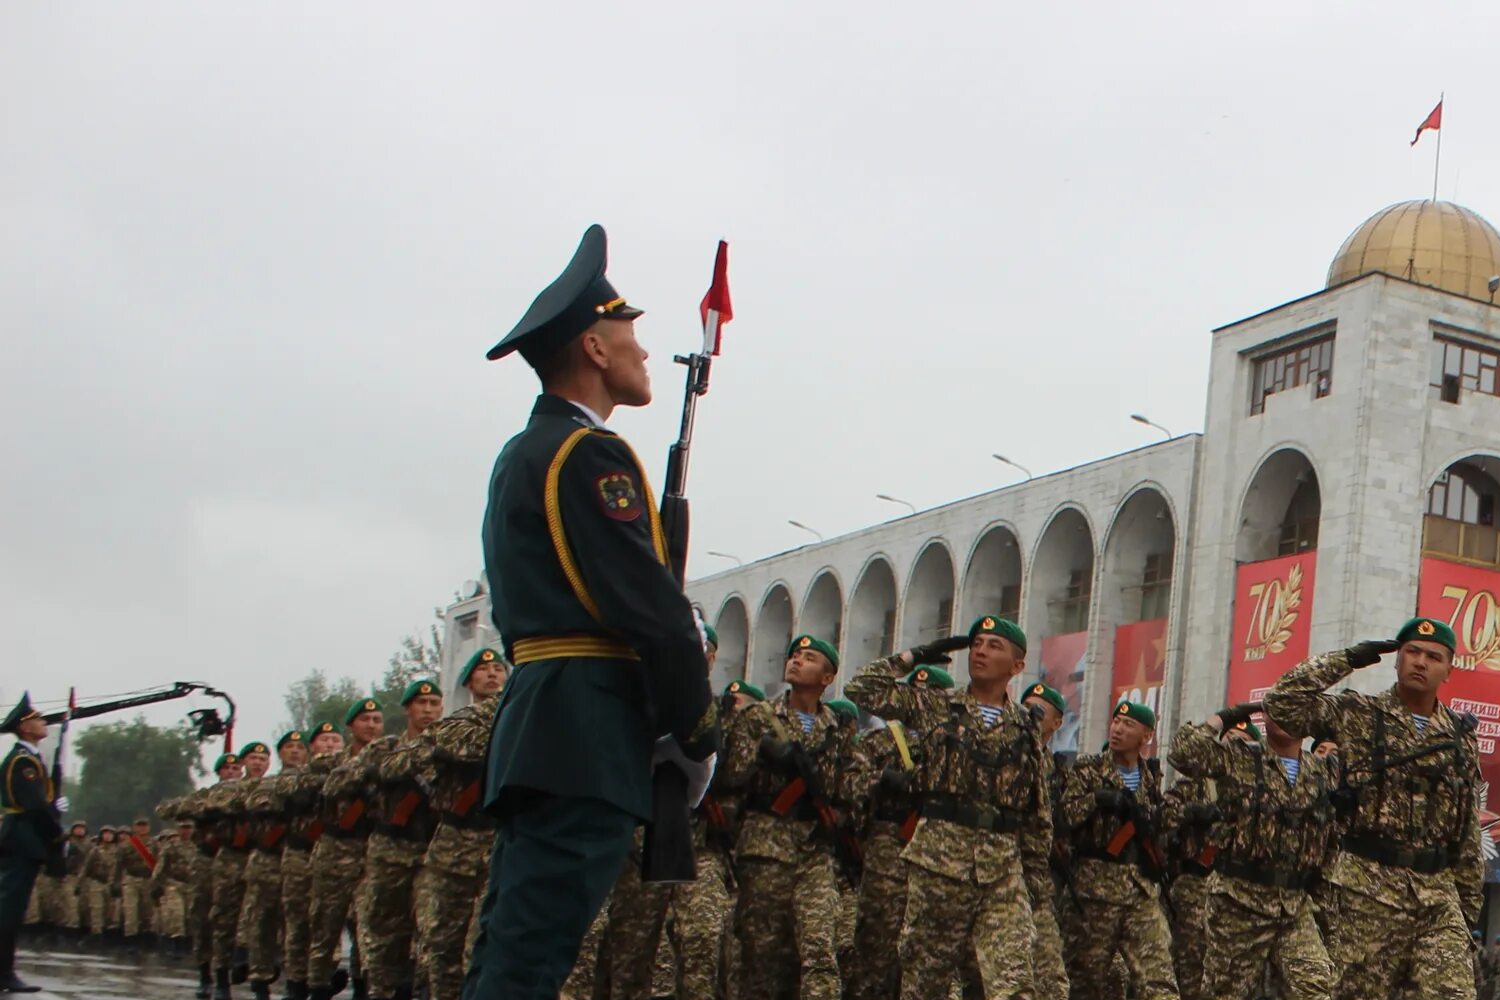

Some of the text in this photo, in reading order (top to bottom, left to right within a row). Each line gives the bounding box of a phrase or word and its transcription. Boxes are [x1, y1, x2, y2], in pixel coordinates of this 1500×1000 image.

[1245, 579, 1281, 644] 70
[1442, 585, 1496, 653] 70
[1451, 654, 1476, 671] ЫЛ
